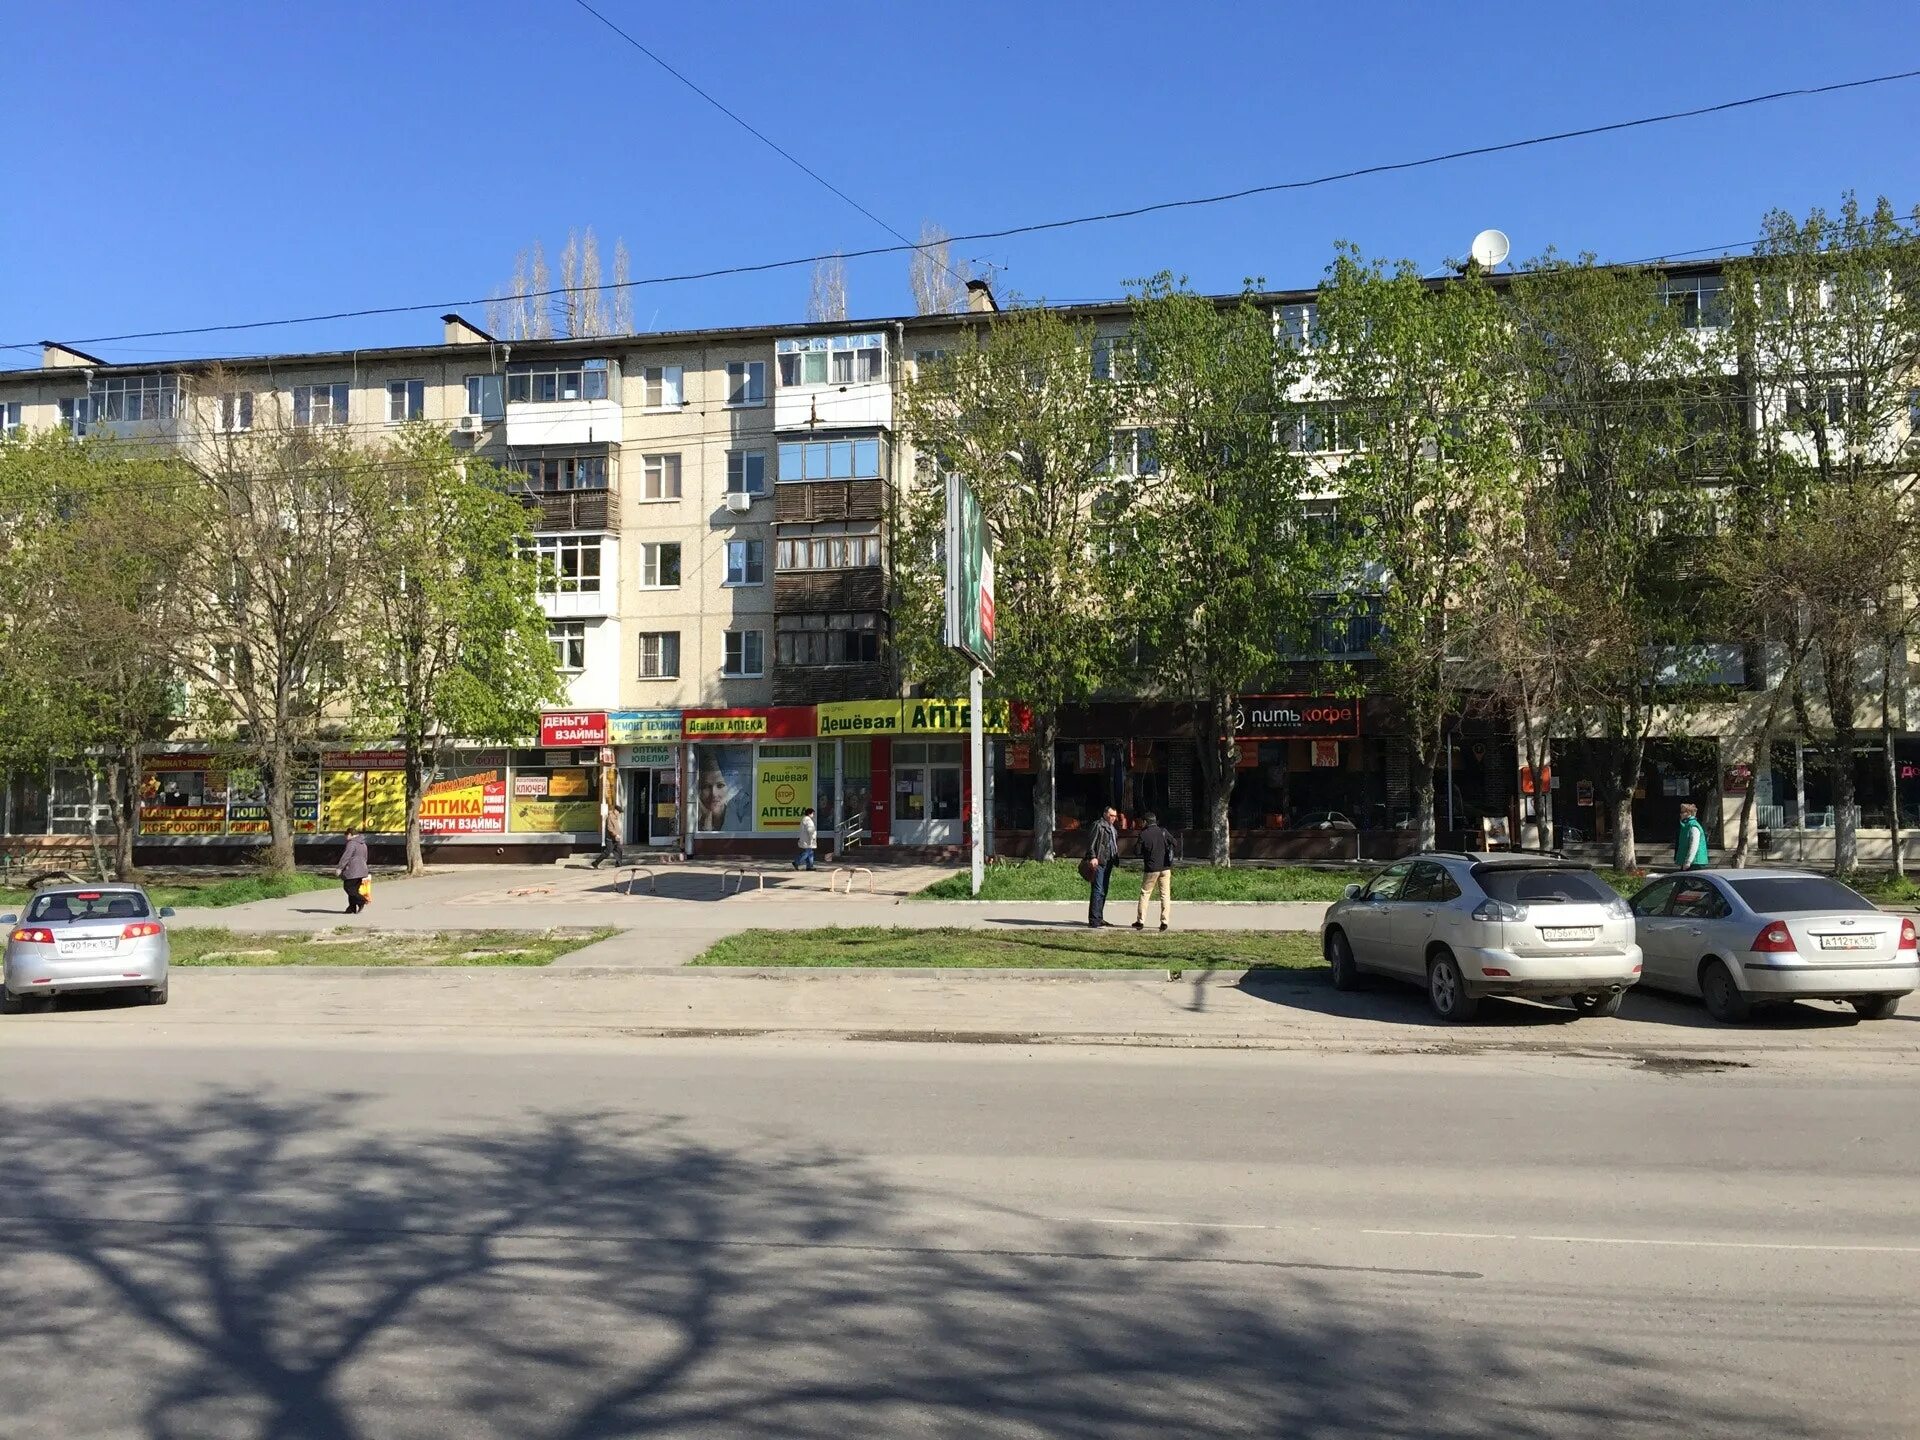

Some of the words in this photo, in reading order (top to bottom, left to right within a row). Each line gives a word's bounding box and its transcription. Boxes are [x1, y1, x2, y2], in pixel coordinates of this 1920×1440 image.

[544, 716, 589, 728] ДЕНЬГИ
[728, 719, 763, 730] АПТЕКА
[821, 714, 896, 734] Дешёвая
[911, 705, 1004, 728] АПТЕА
[612, 721, 643, 731] РЕМОНТ
[647, 720, 682, 731] ТЕХНИКИ
[555, 727, 604, 740] ВЗАЙМЫ
[632, 745, 669, 753] ОПТИКА
[631, 754, 670, 763] ЮВЕЛИР
[762, 771, 808, 783] Дешёвая
[516, 783, 547, 793] КЛЮЧЕЙ
[419, 799, 481, 814] ОПТИКА
[142, 808, 225, 819] КАНЦТОВАРЫ
[232, 807, 268, 818] ПОШИ
[144, 822, 222, 833] КСЕРОКОПИЯ
[231, 822, 261, 832] РЕМОНТ
[458, 816, 502, 830] ВЗАЙМЫ
[1825, 936, 1860, 946] А112ТК
